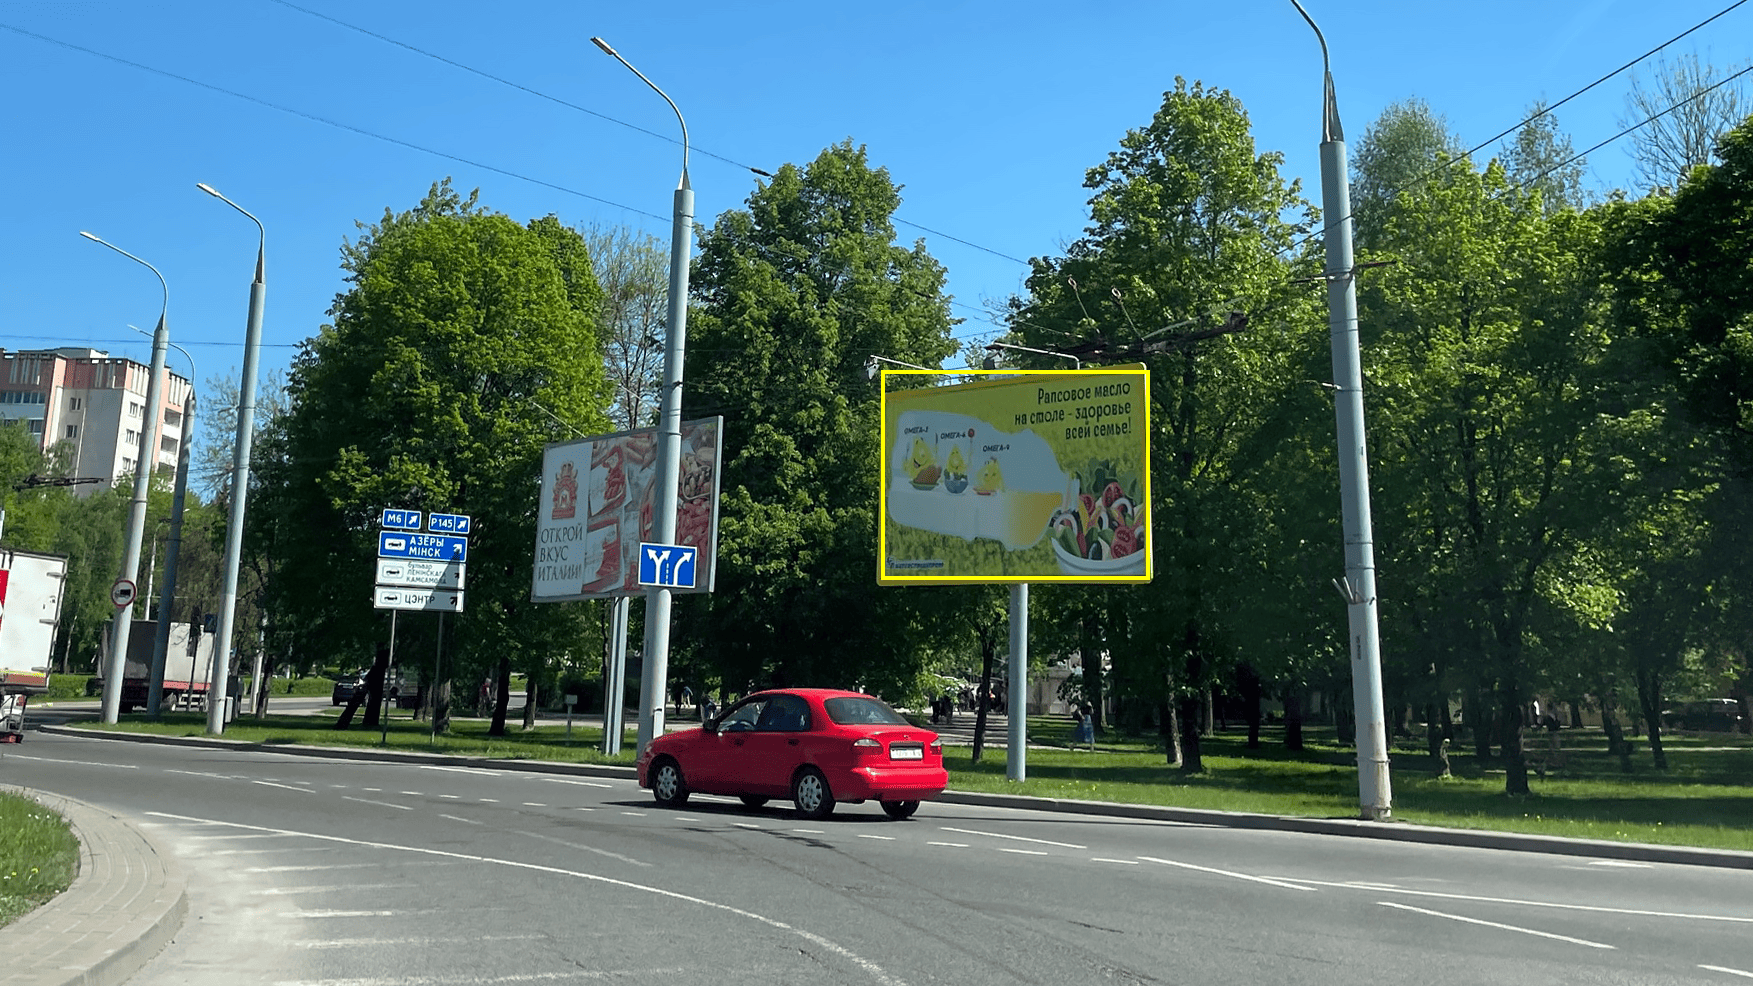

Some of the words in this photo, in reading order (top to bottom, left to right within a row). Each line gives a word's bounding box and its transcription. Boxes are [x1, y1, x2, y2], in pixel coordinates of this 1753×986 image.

[1037, 386, 1091, 405] Рапсовое
[1094, 382, 1131, 398] масло
[1014, 413, 1027, 426] на
[1029, 409, 1065, 425] столе
[1075, 402, 1132, 423] здоровье
[1065, 420, 1091, 440] всей
[1093, 416, 1132, 438] семье!
[387, 513, 402, 524] М6
[409, 535, 445, 548] АЗЁРЫ
[541, 522, 583, 544] ОТКРОЙ
[408, 546, 441, 558] МІНСК
[540, 545, 569, 563] ВКУС
[538, 563, 582, 581] ИТАЛИИ!
[404, 594, 436, 605] ЦЭНТР
